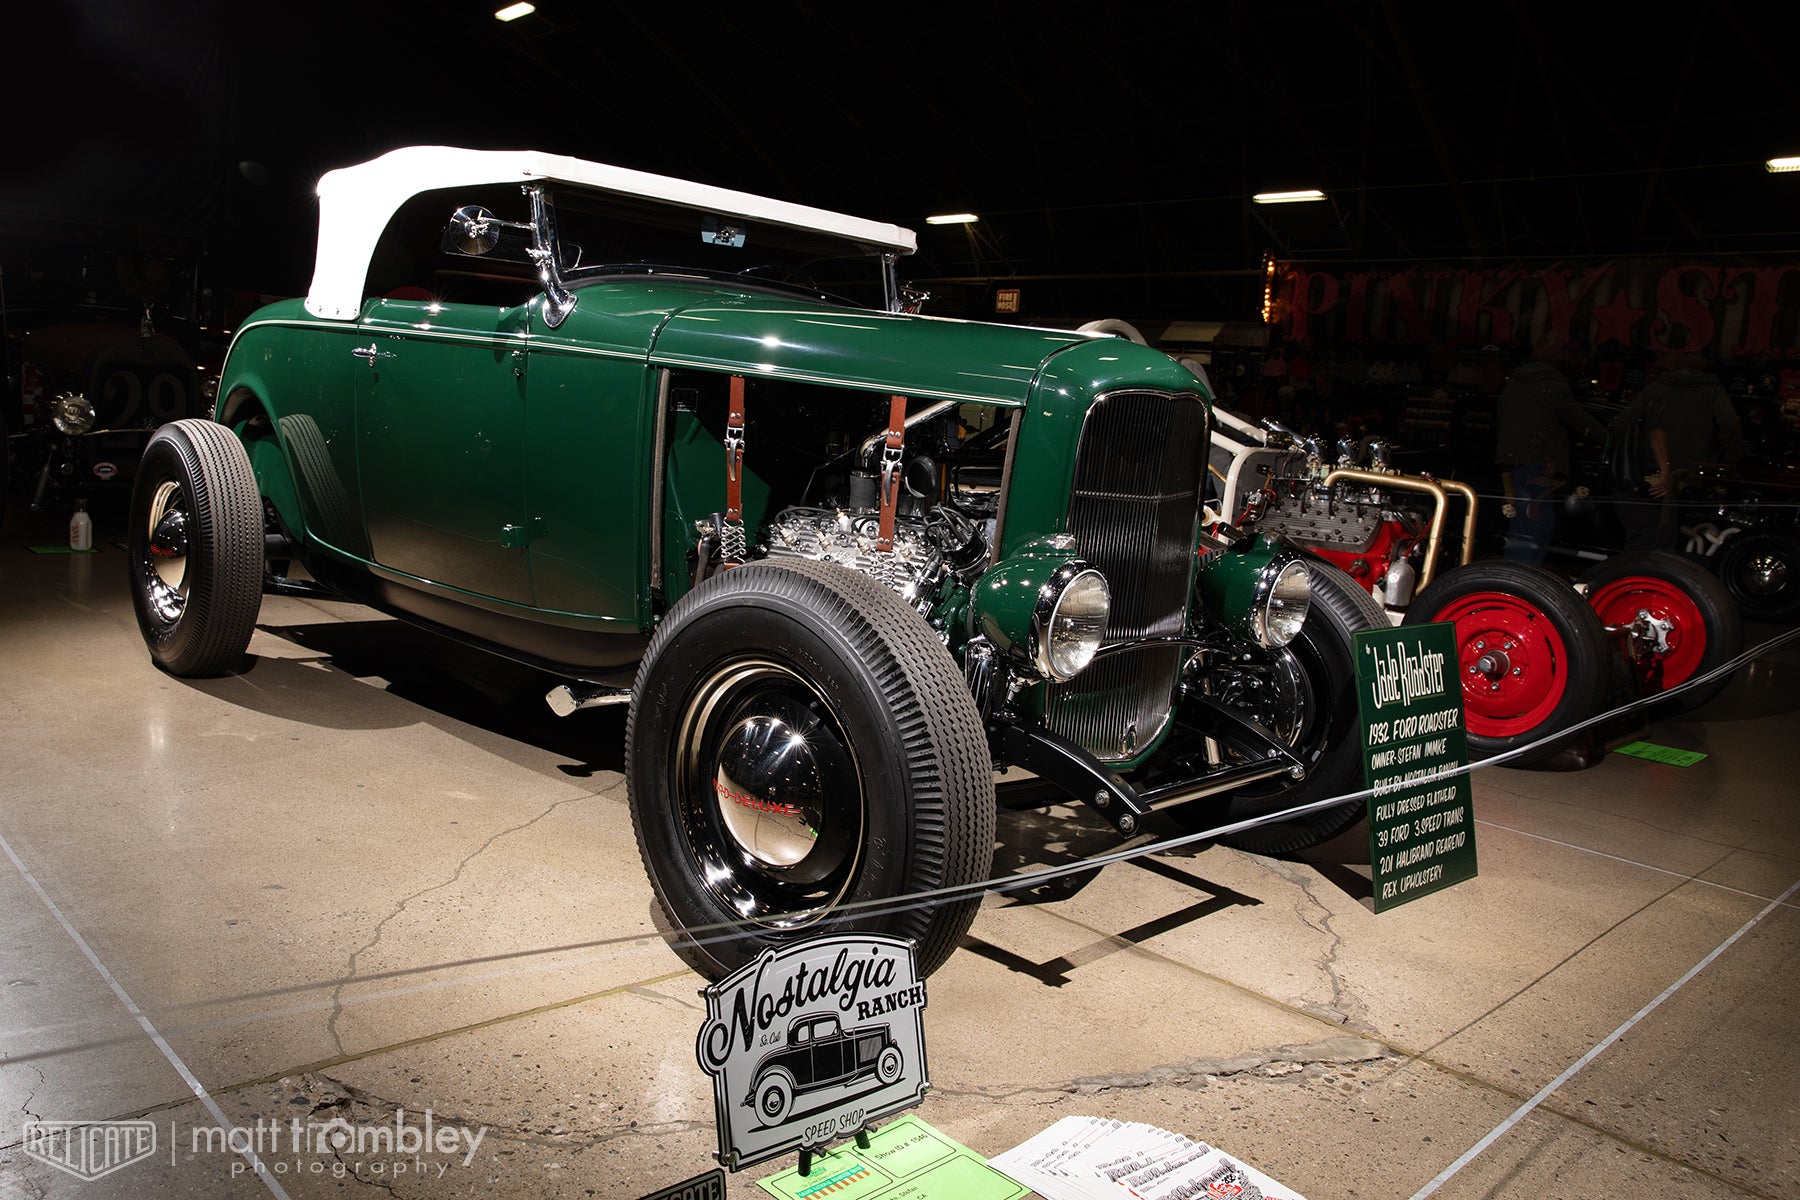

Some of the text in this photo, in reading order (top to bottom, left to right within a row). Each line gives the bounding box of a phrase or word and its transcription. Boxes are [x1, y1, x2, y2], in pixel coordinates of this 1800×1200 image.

[1283, 264, 1800, 357] PINKY ST
[1397, 640, 1444, 706] Roadster
[1369, 708, 1459, 745] 1932 FORD ROADSTER
[1376, 786, 1457, 821] FULLY DRESSED FLATHEAD
[1390, 823, 1410, 843] FORD
[1443, 806, 1464, 828] TRANS
[1379, 831, 1466, 875] 201 HALIBRAND REAREND
[1382, 864, 1443, 900] REX UPHOLSTERY
[706, 946, 896, 1066] Nostalgia
[856, 985, 923, 1021] RANCH
[804, 1108, 865, 1143] SPEED SHOP
